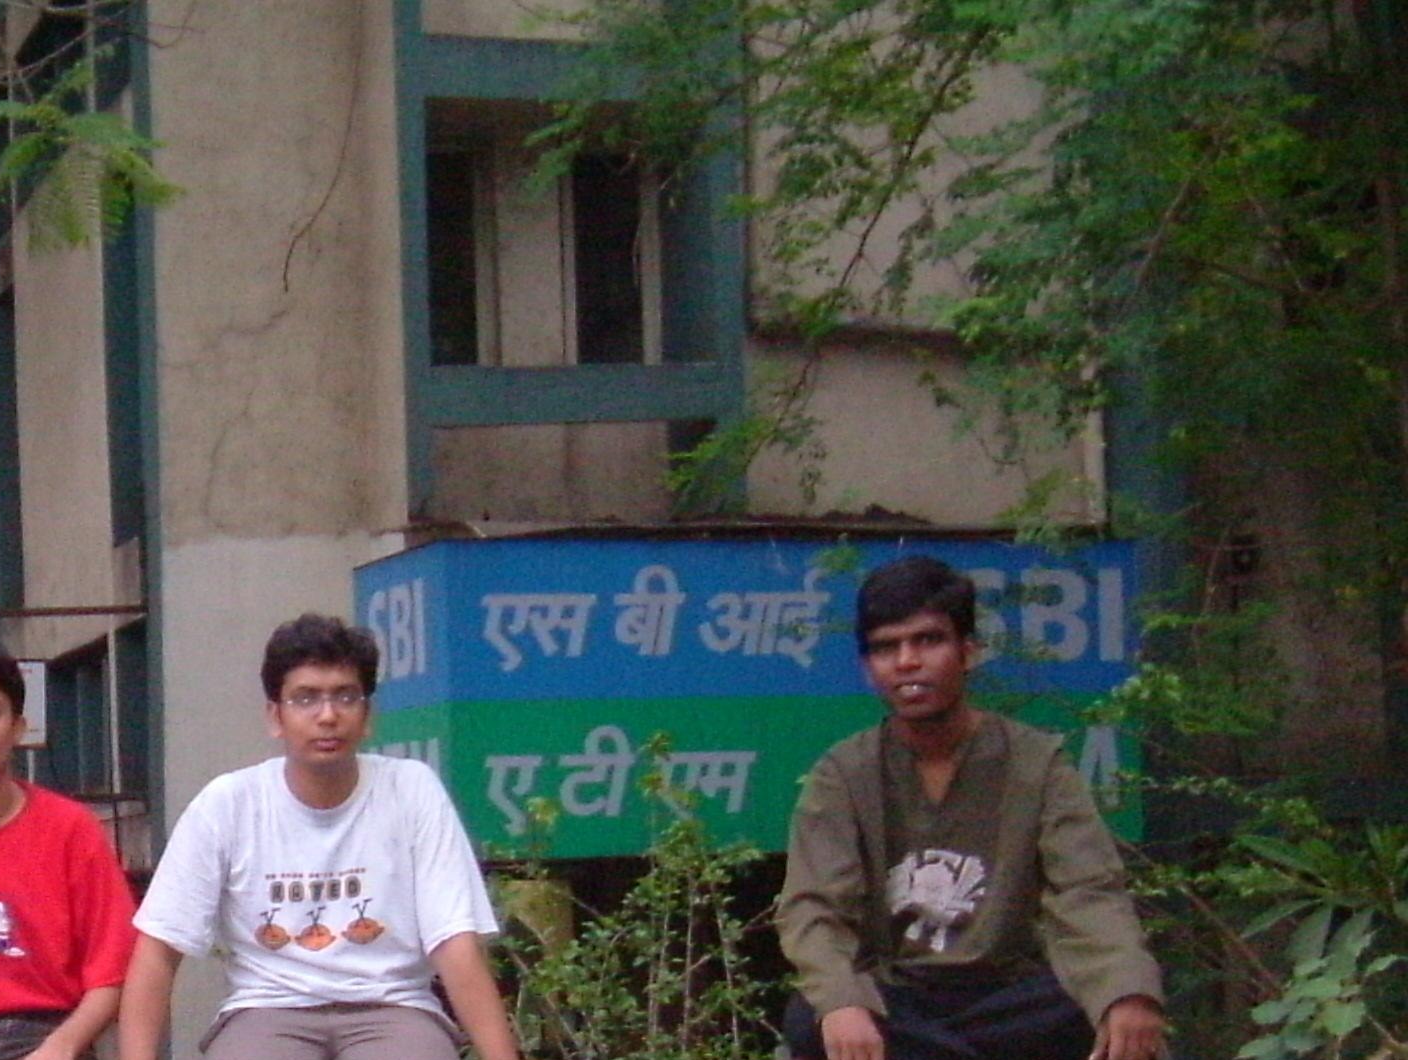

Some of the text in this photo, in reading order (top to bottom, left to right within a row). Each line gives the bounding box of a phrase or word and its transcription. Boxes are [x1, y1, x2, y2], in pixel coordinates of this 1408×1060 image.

[368, 577, 426, 686] SBI
[481, 564, 832, 673] एस बी आई
[485, 754, 542, 837] ए
[558, 724, 636, 819] टी
[652, 750, 758, 824] एम
